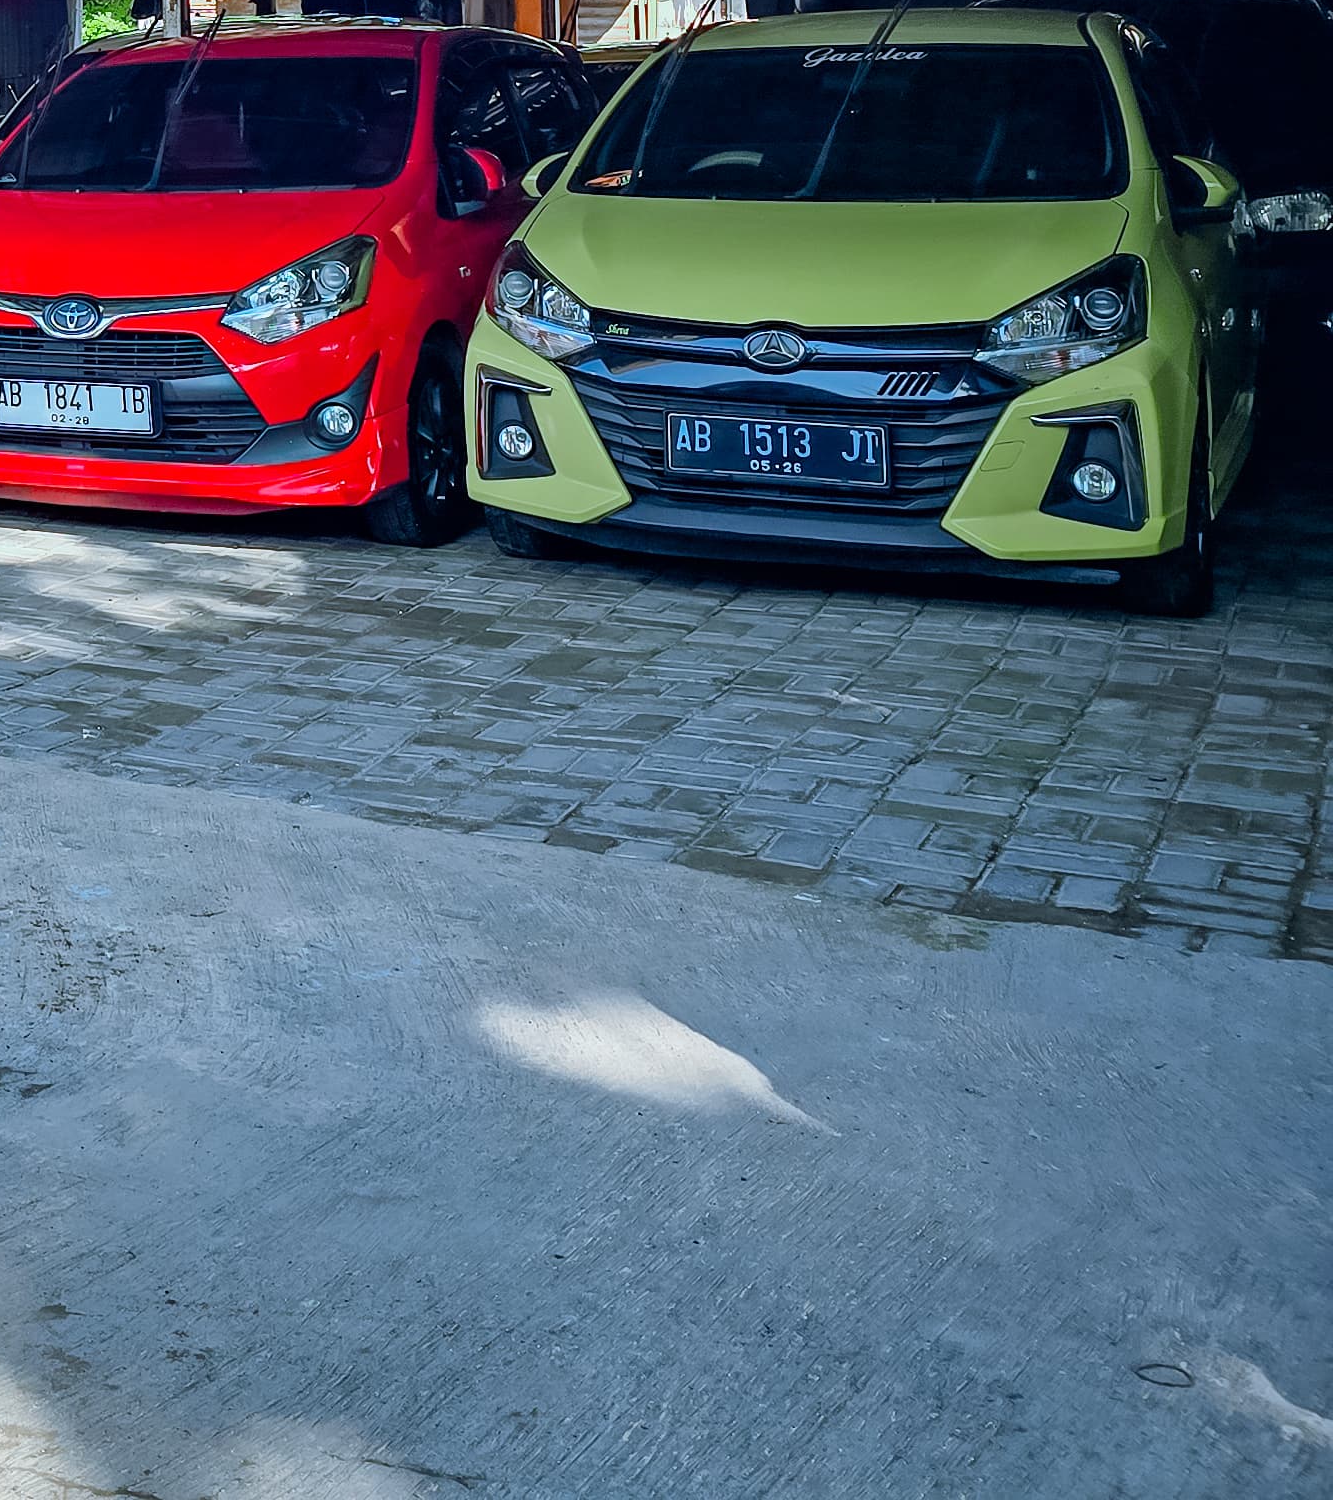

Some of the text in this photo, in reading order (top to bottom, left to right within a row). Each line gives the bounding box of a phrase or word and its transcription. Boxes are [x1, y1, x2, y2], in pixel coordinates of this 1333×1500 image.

[44, 383, 94, 412] 1841
[676, 419, 711, 452] AB
[739, 423, 811, 458] 1513
